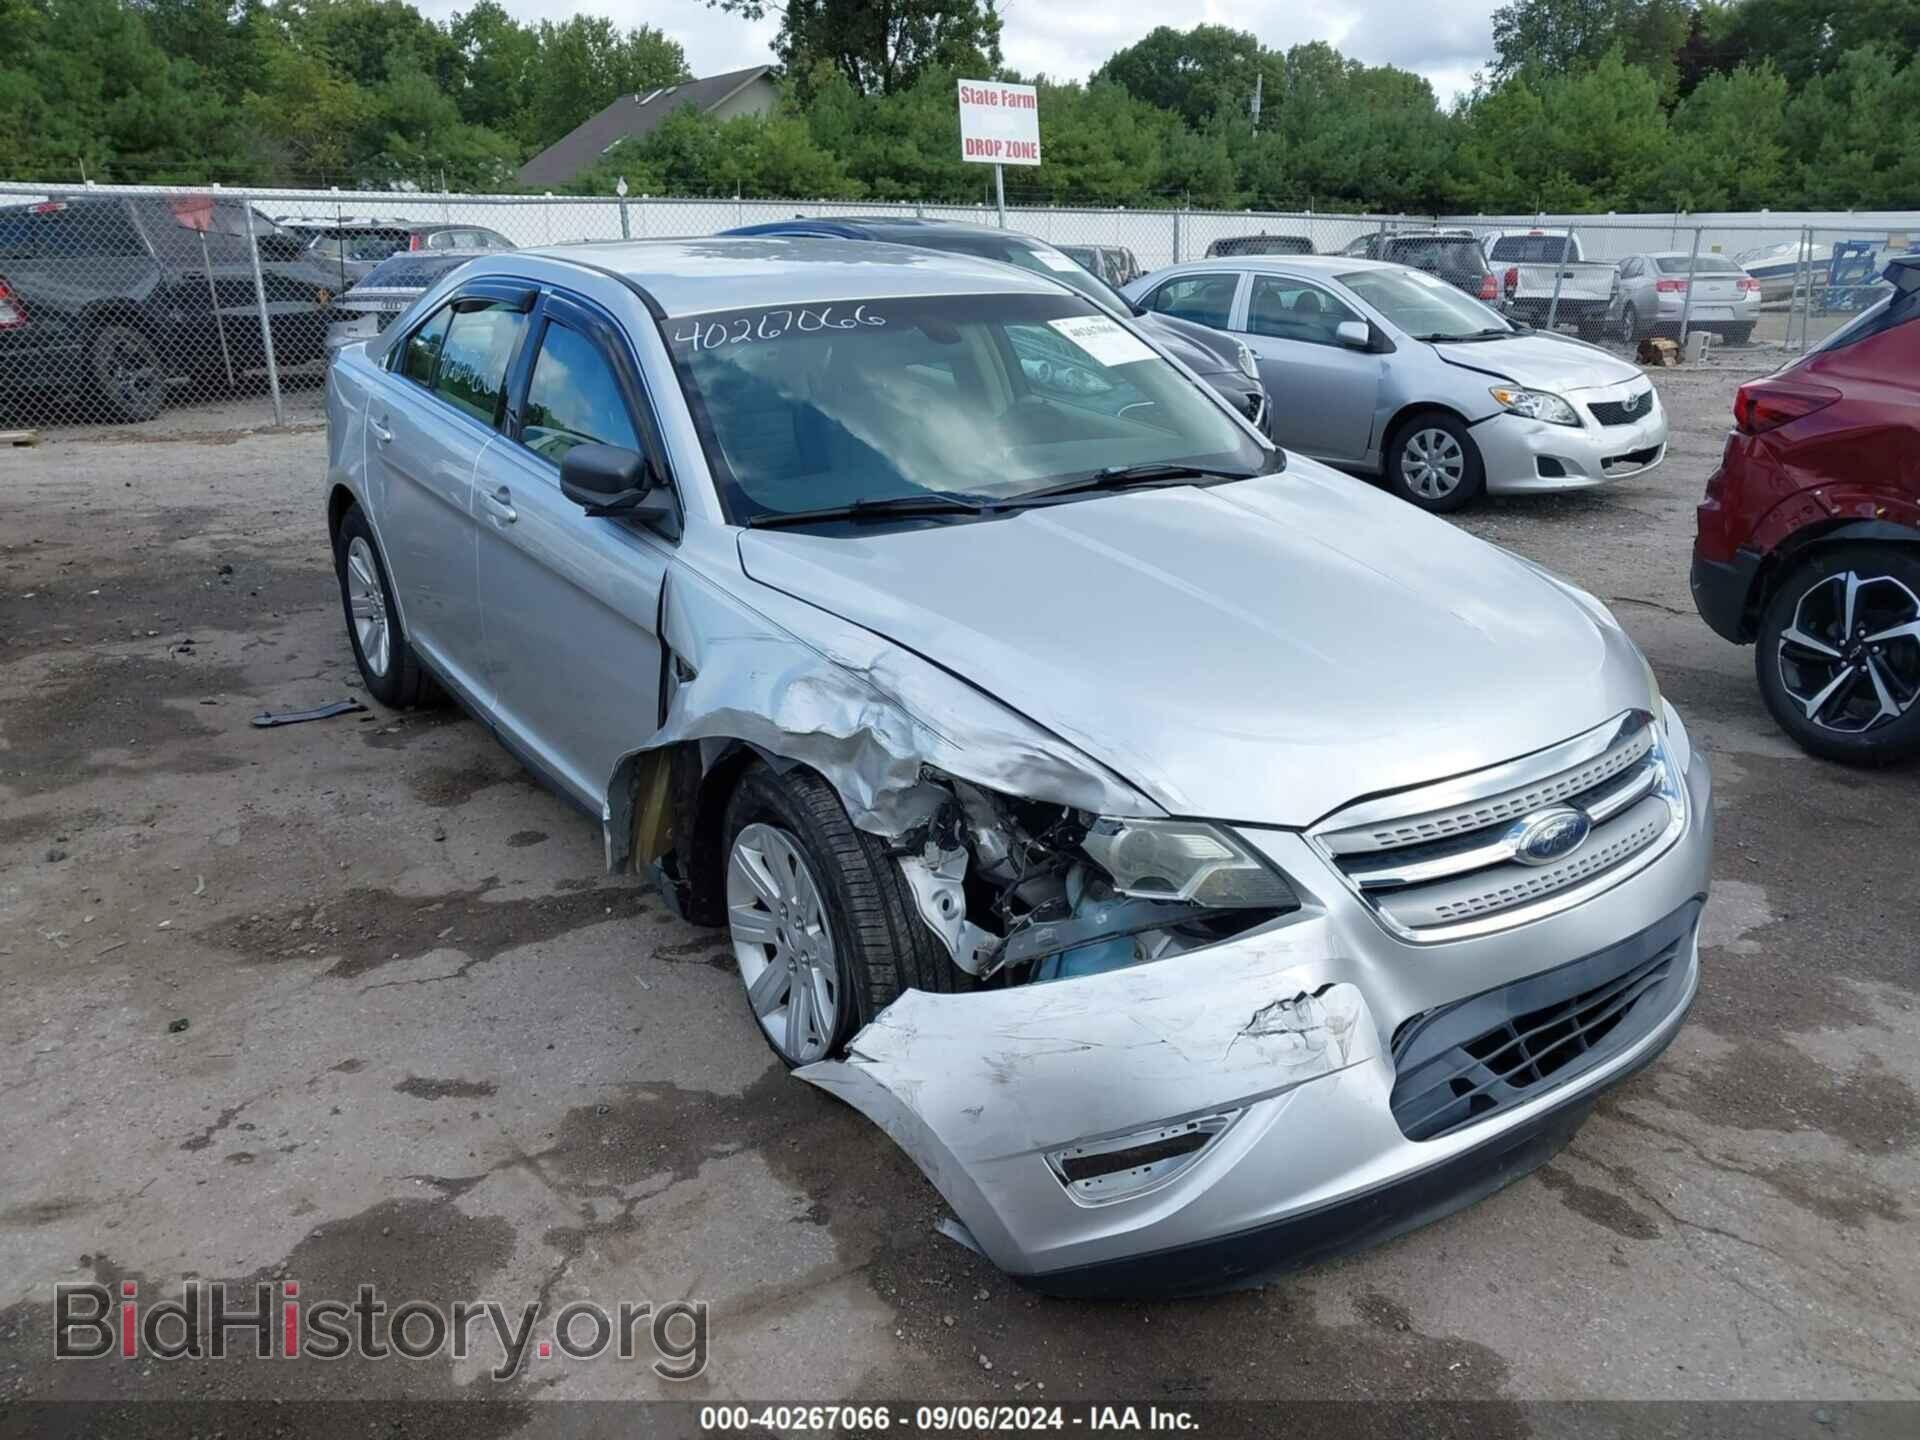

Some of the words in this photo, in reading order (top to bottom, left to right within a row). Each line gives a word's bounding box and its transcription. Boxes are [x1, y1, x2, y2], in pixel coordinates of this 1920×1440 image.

[961, 86, 998, 106] State
[1001, 89, 1035, 109] Farm
[965, 138, 1002, 157] DROP
[1005, 141, 1037, 159] ZONE
[674, 304, 886, 351] 40267066
